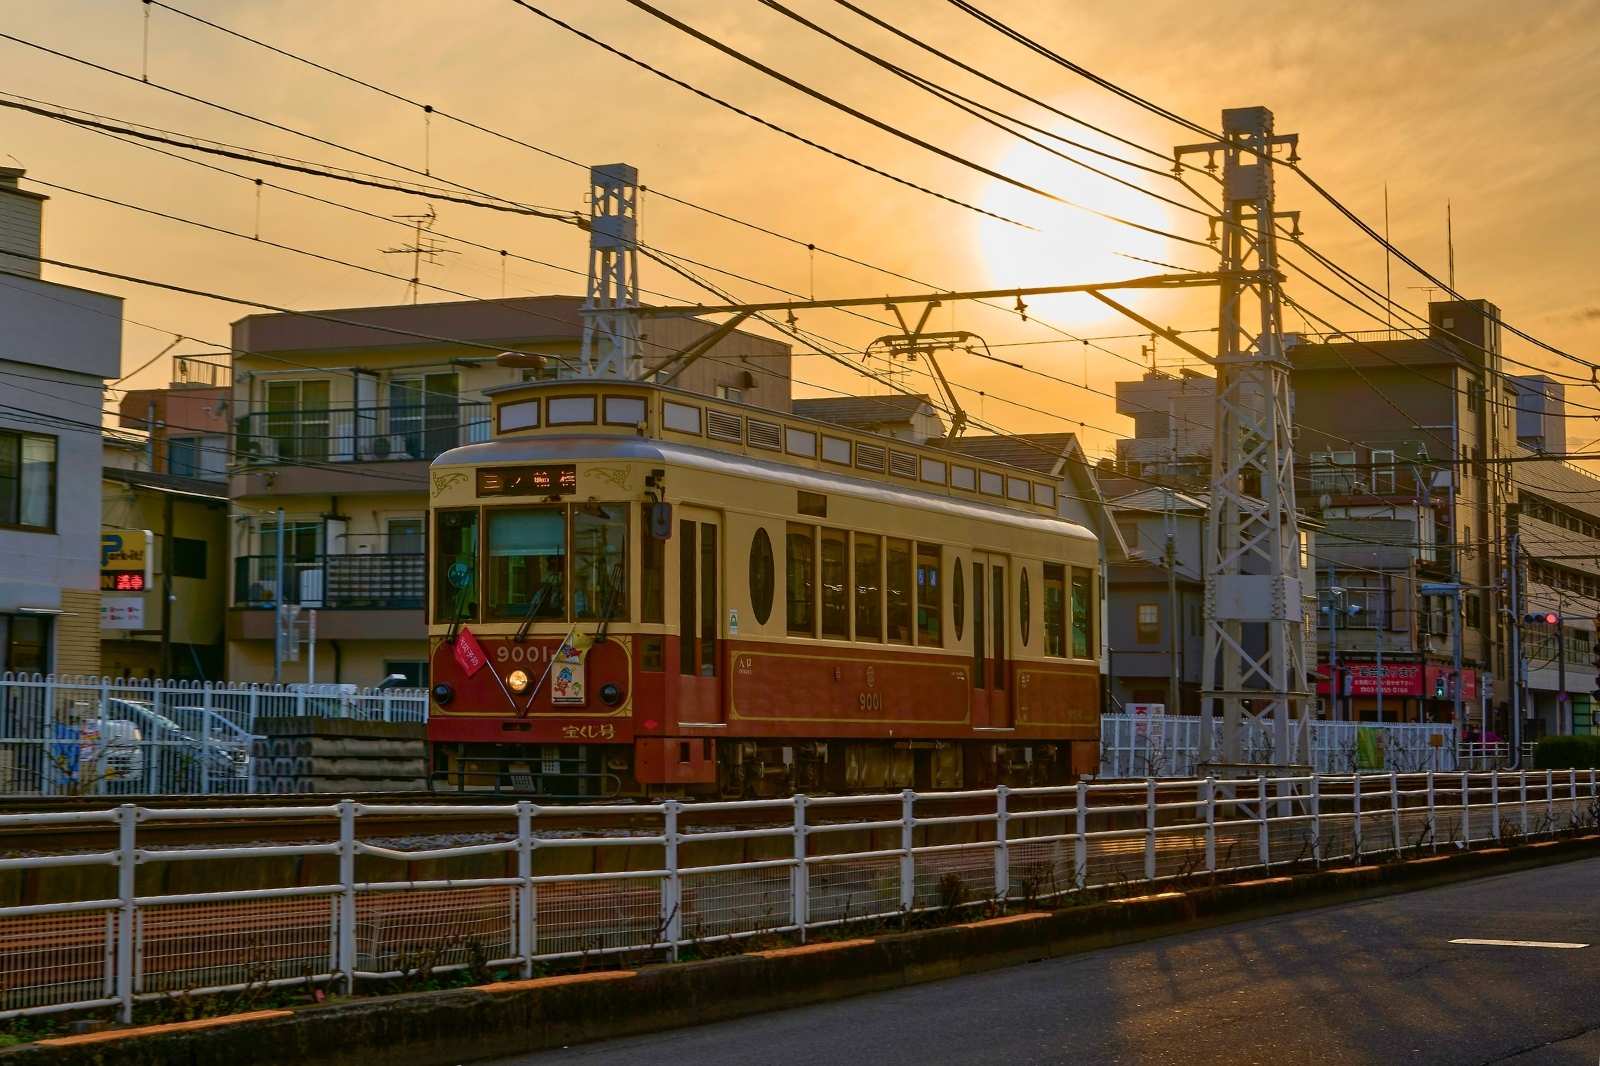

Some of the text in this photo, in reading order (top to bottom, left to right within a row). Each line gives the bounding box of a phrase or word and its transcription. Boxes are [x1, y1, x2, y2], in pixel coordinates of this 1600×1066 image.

[497, 646, 548, 662] 9001
[859, 692, 882, 711] 9001
[562, 723, 615, 740] 宝くじ号
